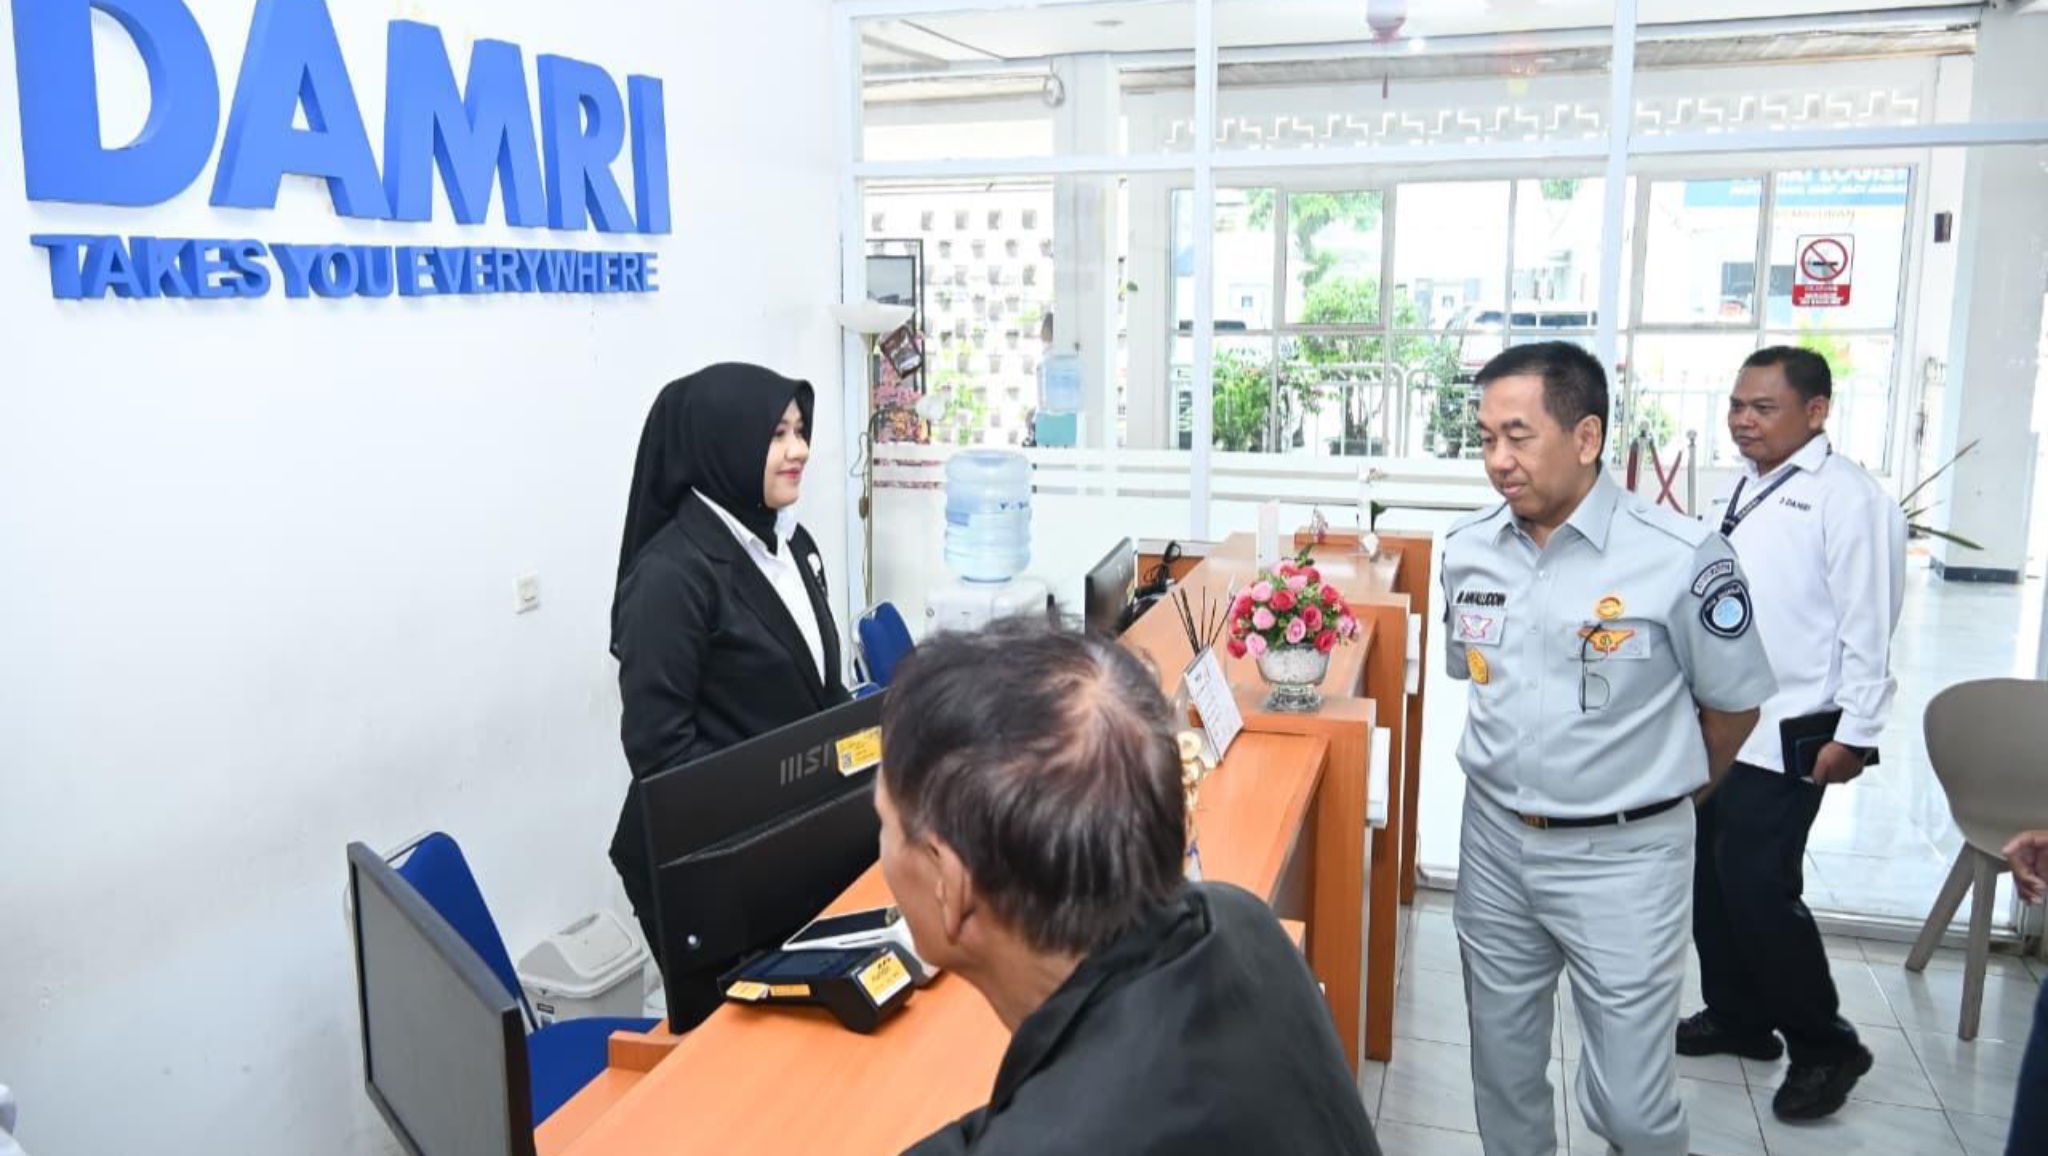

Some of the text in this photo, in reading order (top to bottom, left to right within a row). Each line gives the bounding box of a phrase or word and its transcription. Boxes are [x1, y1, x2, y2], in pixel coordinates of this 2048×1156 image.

[11, 0, 671, 234] DAMRI
[30, 234, 660, 300] TAKES YOU EVERYWHERE
[780, 742, 829, 787] MSI
